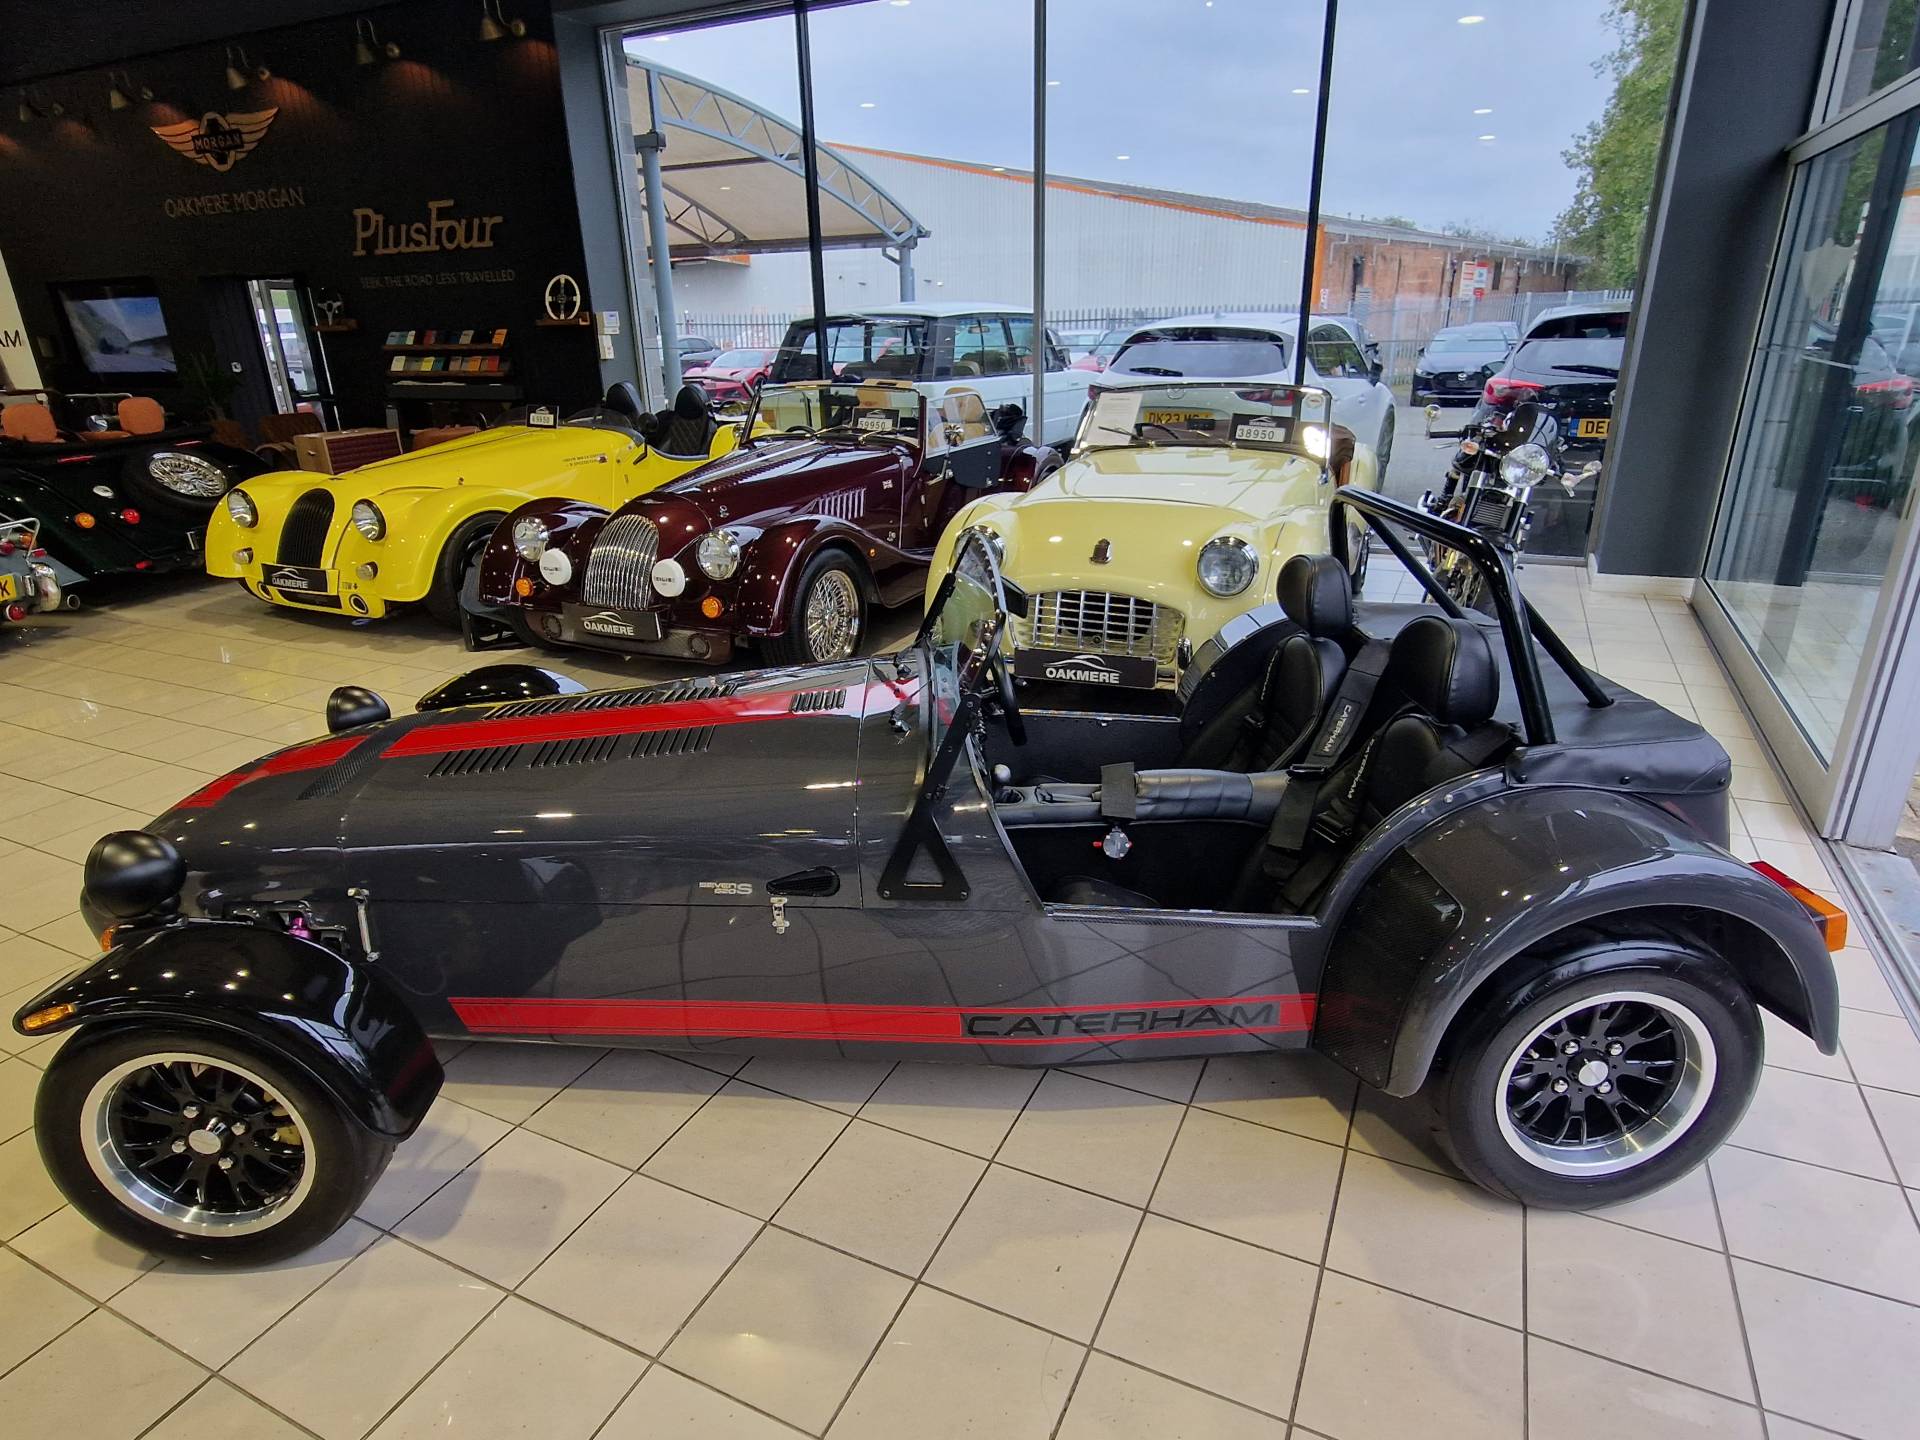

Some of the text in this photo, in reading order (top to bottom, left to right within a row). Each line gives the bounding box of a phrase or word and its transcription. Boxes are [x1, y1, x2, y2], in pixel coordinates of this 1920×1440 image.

[193, 132, 240, 152] MORGAN
[164, 186, 305, 218] OAKMERE MORGAN
[402, 273, 432, 287] ROAD
[435, 271, 456, 285] LESS
[458, 268, 515, 284] TRAVELLED
[860, 420, 886, 431] 59950
[1237, 428, 1275, 440] 38950
[271, 577, 309, 589] OAKMERE
[583, 620, 634, 636] OAKMERE
[1045, 667, 1120, 684] OAKMERE
[1322, 704, 1352, 753] CATERHAM
[966, 1003, 1275, 1037] CATERHAM
